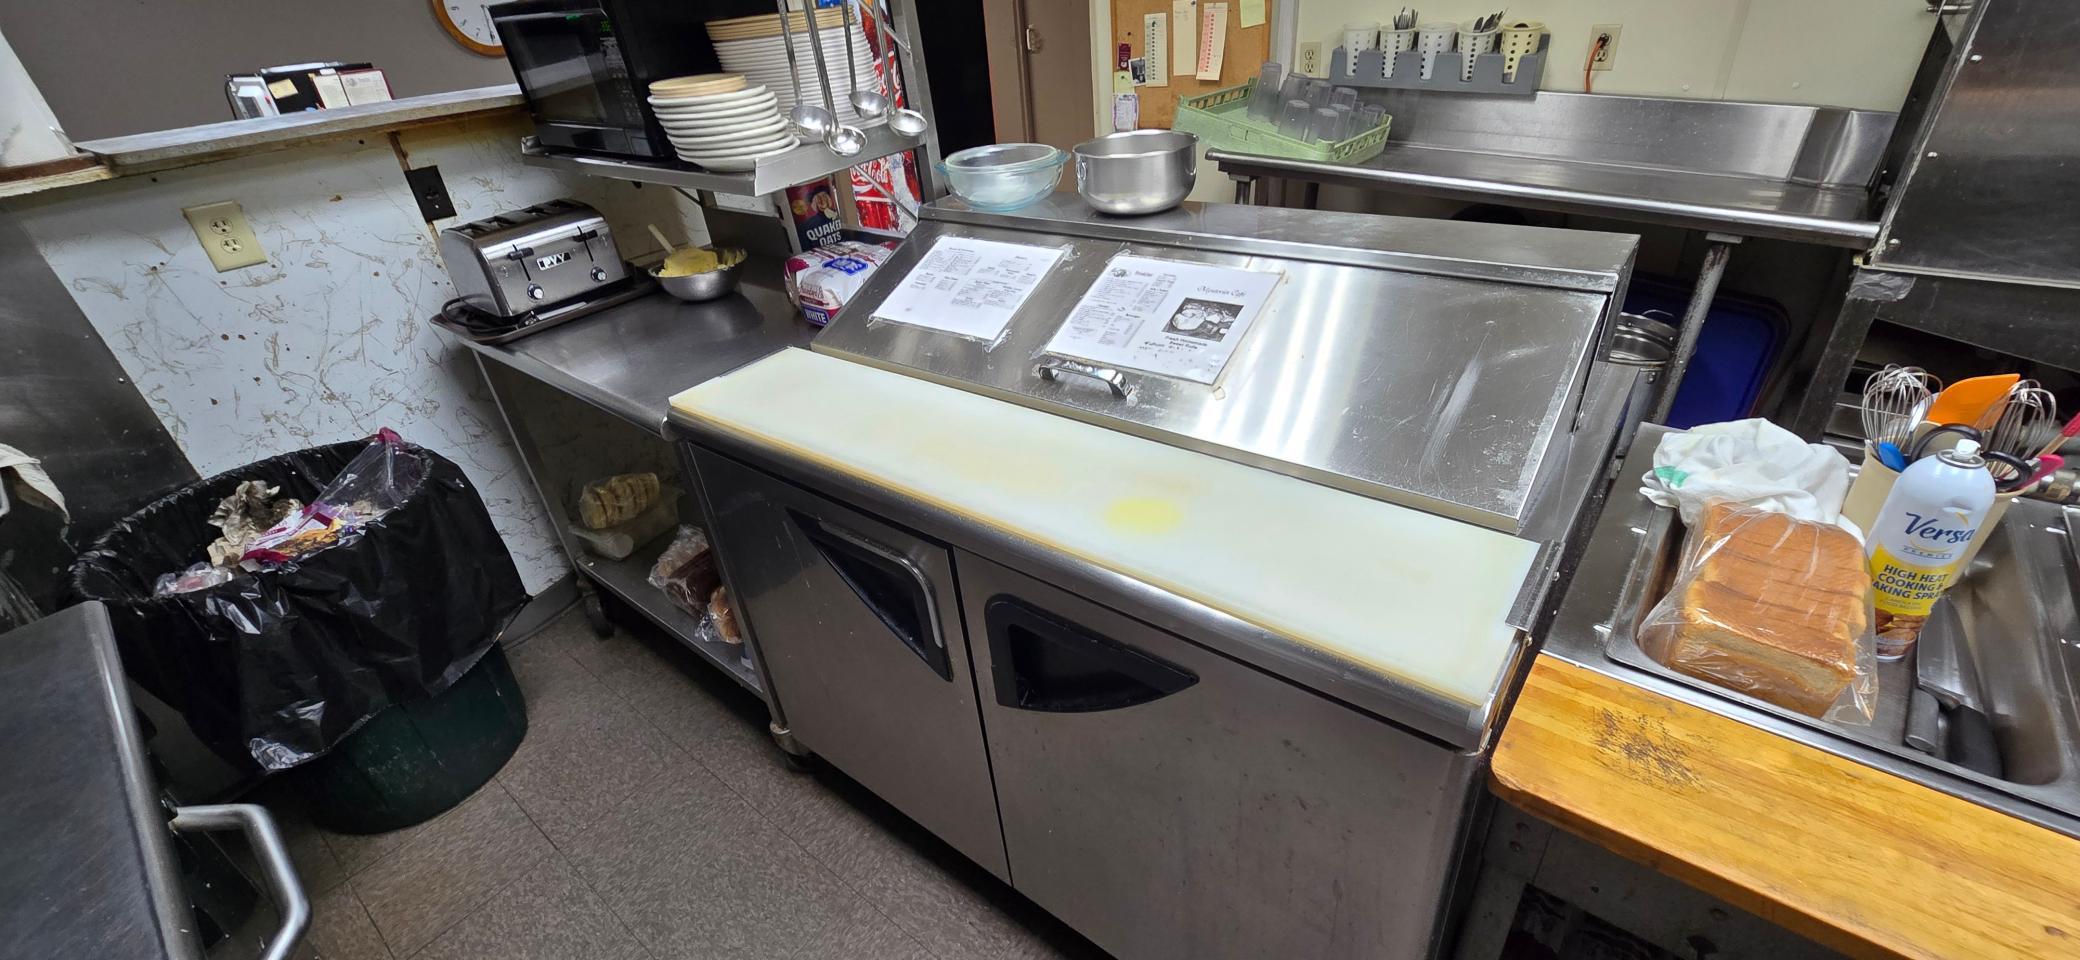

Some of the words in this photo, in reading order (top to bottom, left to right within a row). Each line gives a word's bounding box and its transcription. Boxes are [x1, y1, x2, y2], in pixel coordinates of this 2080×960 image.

[805, 309, 828, 324] WHITE
[1878, 573, 1936, 591] COOKING
[1884, 564, 1917, 580] HIGH
[1919, 573, 1949, 583] HEAT
[1872, 581, 1911, 599] AKING
